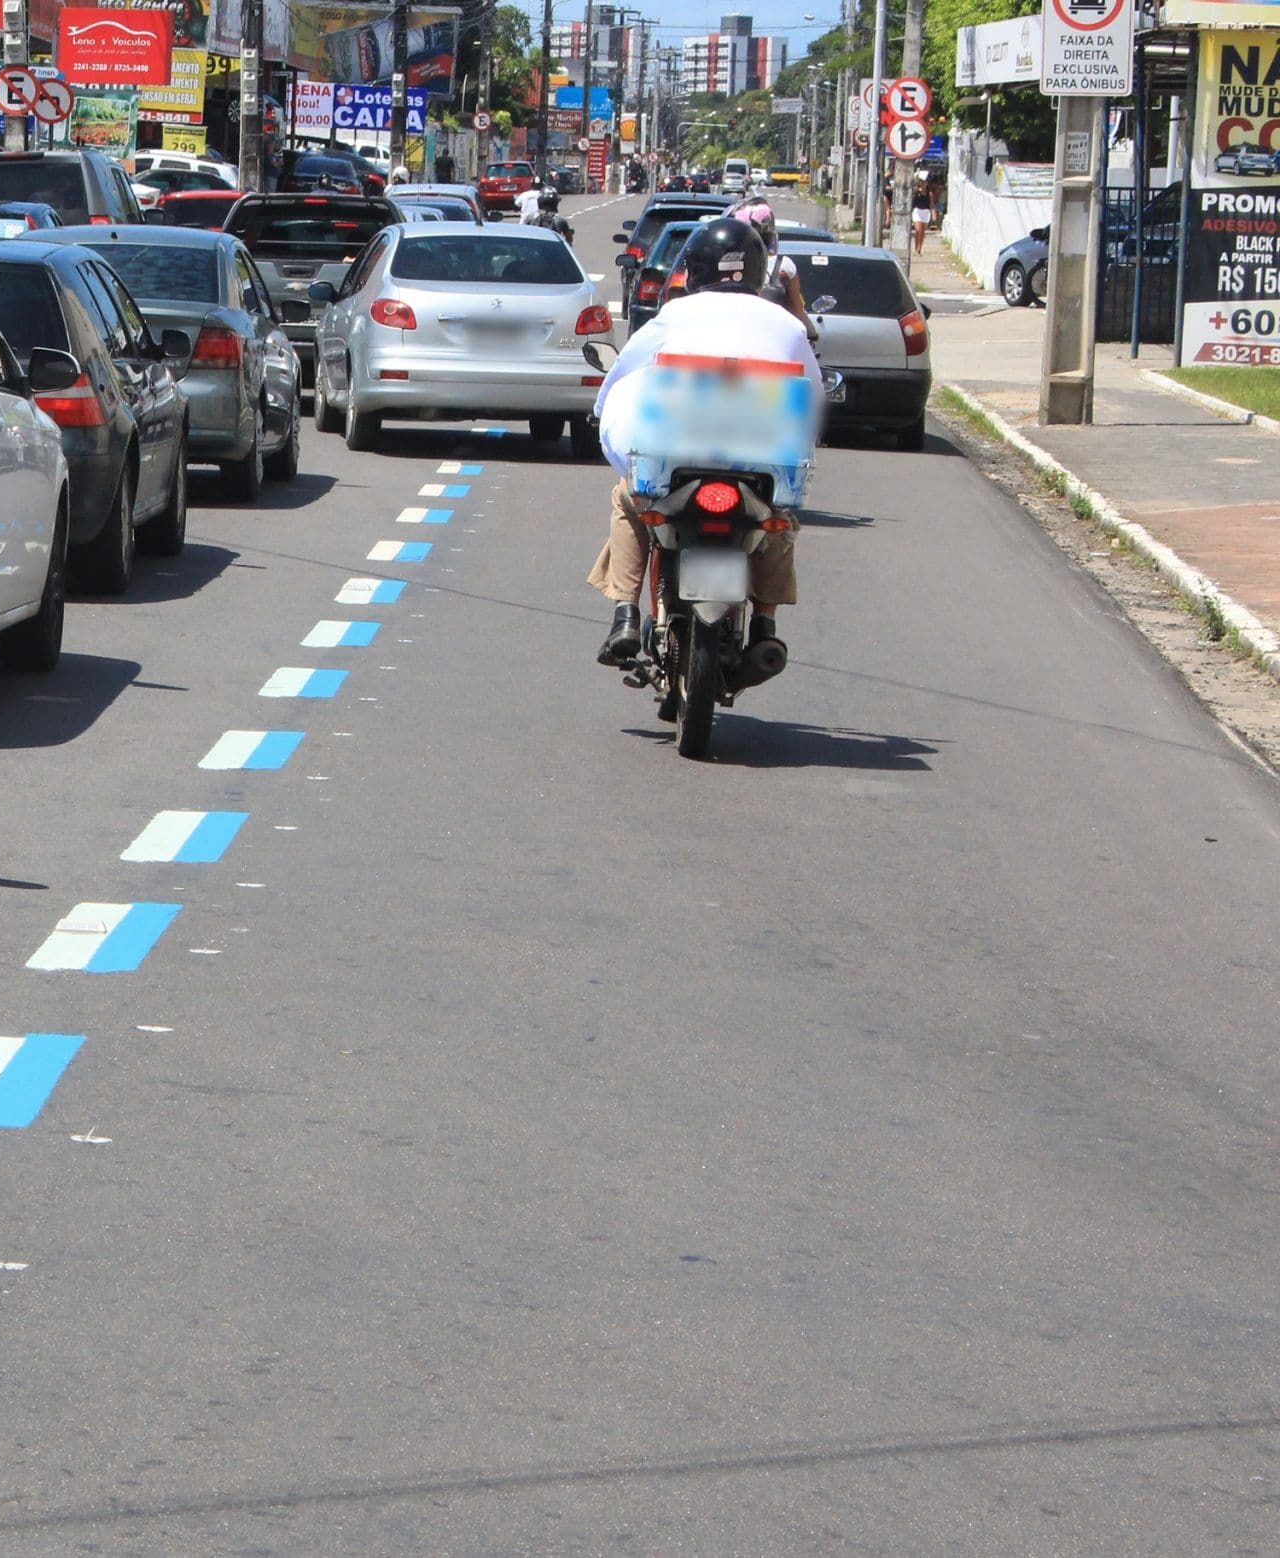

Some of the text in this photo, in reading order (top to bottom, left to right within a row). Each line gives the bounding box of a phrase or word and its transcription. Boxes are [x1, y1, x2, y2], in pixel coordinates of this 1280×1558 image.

[1060, 35, 1114, 46] FAIXA DA
[1064, 49, 1110, 60] DIREITA
[1053, 63, 1119, 75] EXCLUSIVA
[1046, 76, 1126, 90] PARA ÔNIBUS
[1219, 86, 1263, 97] MUDE
[354, 90, 424, 107] Loteas
[1201, 218, 1278, 233] ADESIVO
[1235, 235, 1274, 251] BLACK
[1220, 252, 1273, 264] A PARTIR
[1217, 264, 1245, 294] R$
